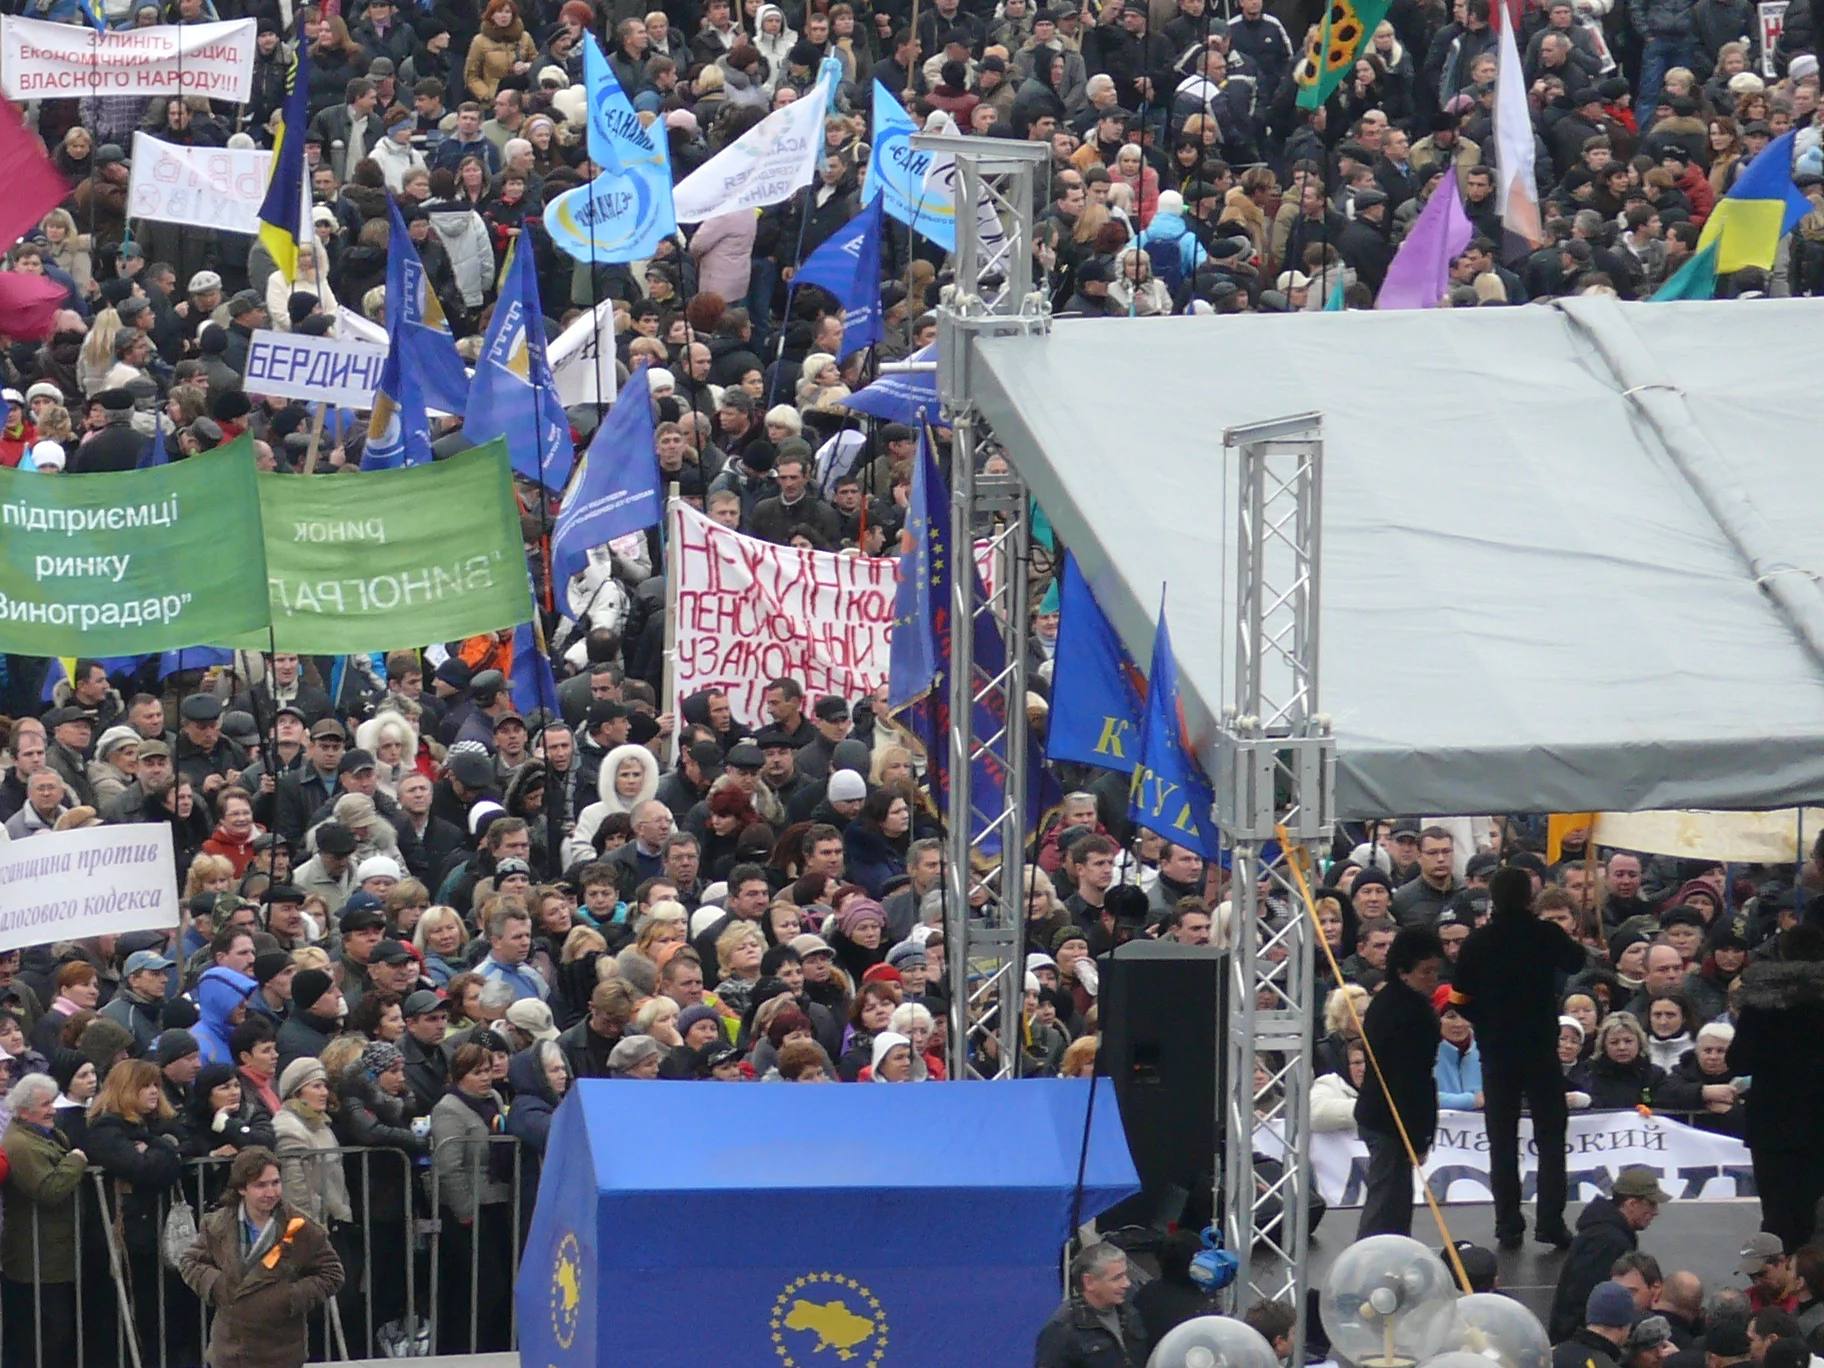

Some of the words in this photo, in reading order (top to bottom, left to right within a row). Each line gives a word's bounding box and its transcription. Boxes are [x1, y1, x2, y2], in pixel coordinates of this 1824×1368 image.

[19, 45, 150, 67] ЕКОНОМІЧНИЙ
[87, 32, 174, 50] ЗУПИНІТЬ
[19, 70, 130, 91] ВЛАСНОГО
[136, 70, 239, 93] НАРОДУ!!!
[2, 493, 179, 533] підприємці
[34, 552, 131, 583] ринку
[77, 842, 159, 877] против
[83, 885, 163, 917] кодекса
